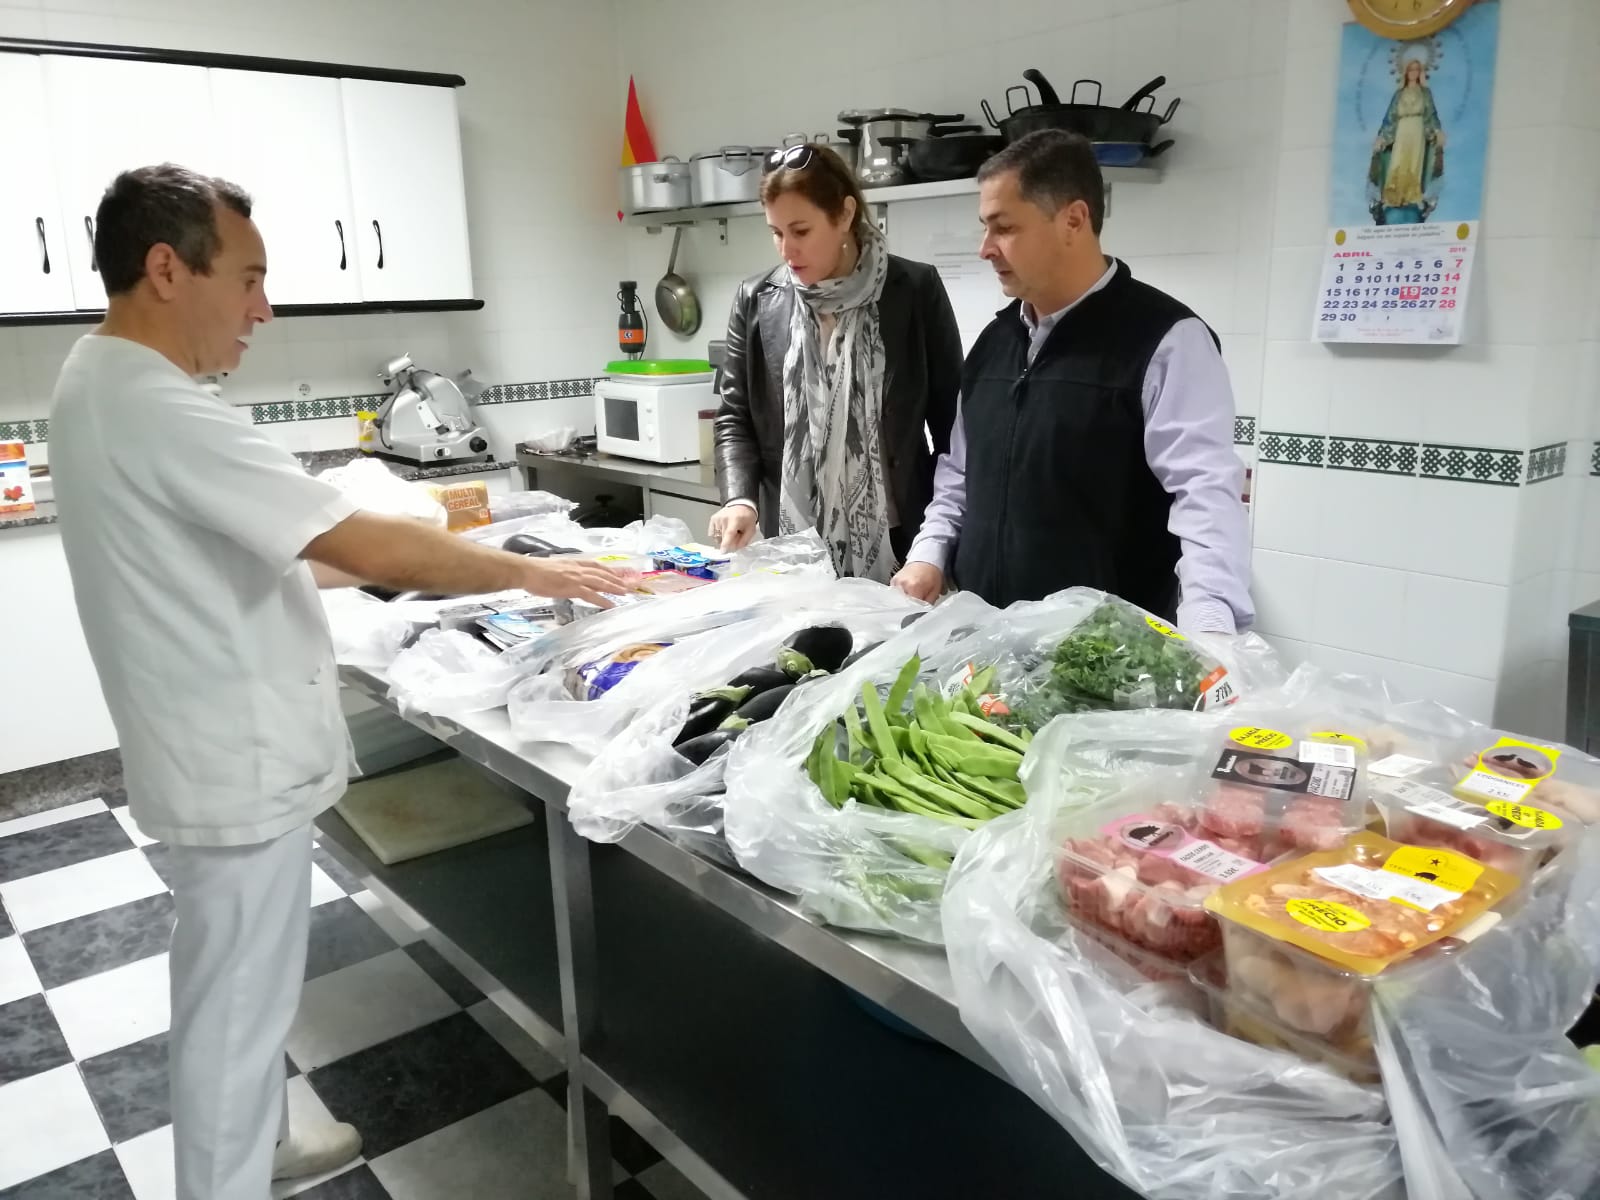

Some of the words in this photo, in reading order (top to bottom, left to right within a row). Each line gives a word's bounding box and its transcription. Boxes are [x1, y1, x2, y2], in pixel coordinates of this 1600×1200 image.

[1376, 262, 1383, 270] 3
[1395, 261, 1403, 269] 4
[1414, 261, 1423, 269] 5
[1434, 260, 1442, 268] 6
[1456, 259, 1463, 267] 7
[1355, 275, 1362, 283] 9
[1367, 275, 1381, 283] 10
[1386, 275, 1400, 283] 11
[1445, 273, 1460, 281] 14
[1365, 288, 1379, 296] 17
[1404, 287, 1419, 295] 19
[1422, 287, 1438, 295] 20
[1439, 300, 1456, 308] 28
[448, 487, 476, 500] MULTI
[448, 499, 480, 511] CEREAL
[1215, 681, 1233, 703] KALE
[1299, 901, 1347, 927] PRECIO
